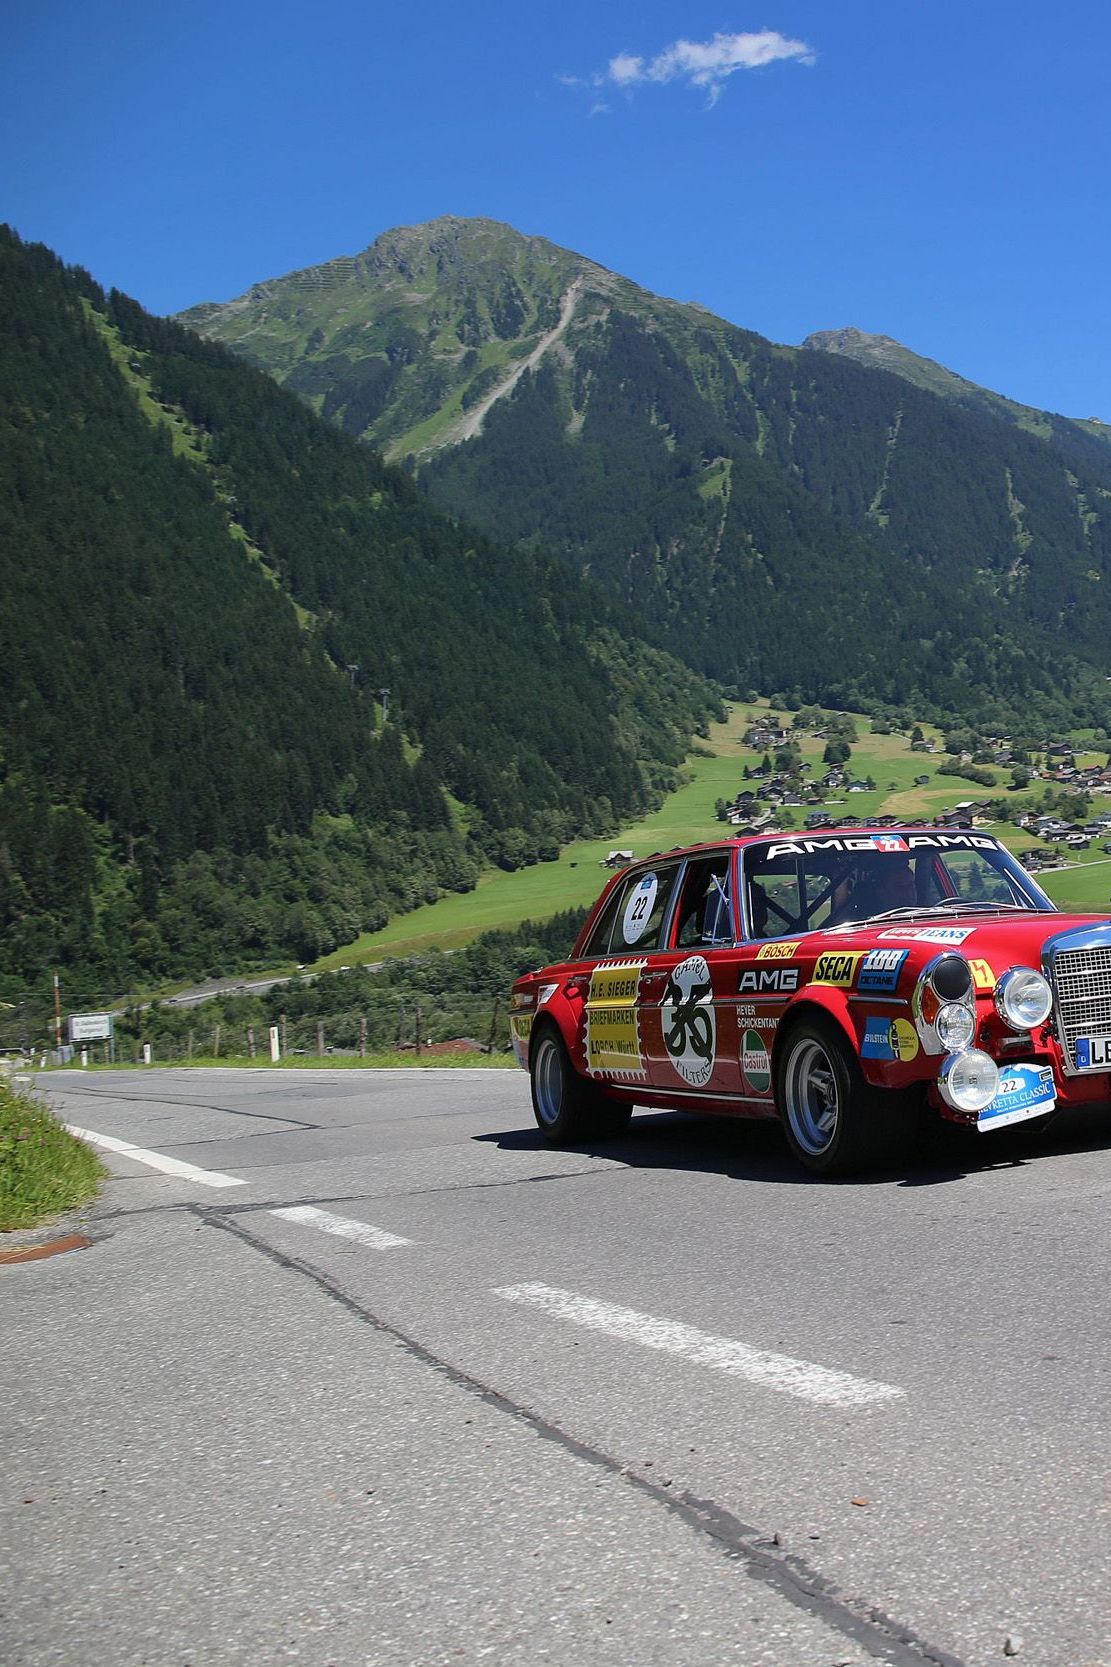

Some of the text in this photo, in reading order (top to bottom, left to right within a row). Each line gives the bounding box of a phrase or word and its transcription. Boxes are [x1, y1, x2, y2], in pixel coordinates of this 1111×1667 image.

[766, 838, 879, 861] AMG
[908, 836, 999, 850] AMG
[631, 896, 648, 920] 22
[763, 946, 794, 958] BOSCH
[863, 950, 905, 970] 100
[674, 959, 705, 981] CAMEL
[816, 957, 854, 980] SECA
[608, 980, 636, 996] SIEGER
[738, 969, 799, 991] AMG
[861, 976, 894, 984] OCTANE
[590, 1009, 635, 1025] BRIEFMARKEN
[736, 1005, 755, 1015] HEYER
[744, 1053, 768, 1070] Castrol
[676, 1060, 711, 1084] FILTERS
[1002, 1080, 1017, 1093] 22
[1020, 1082, 1051, 1101] CLASSIC
